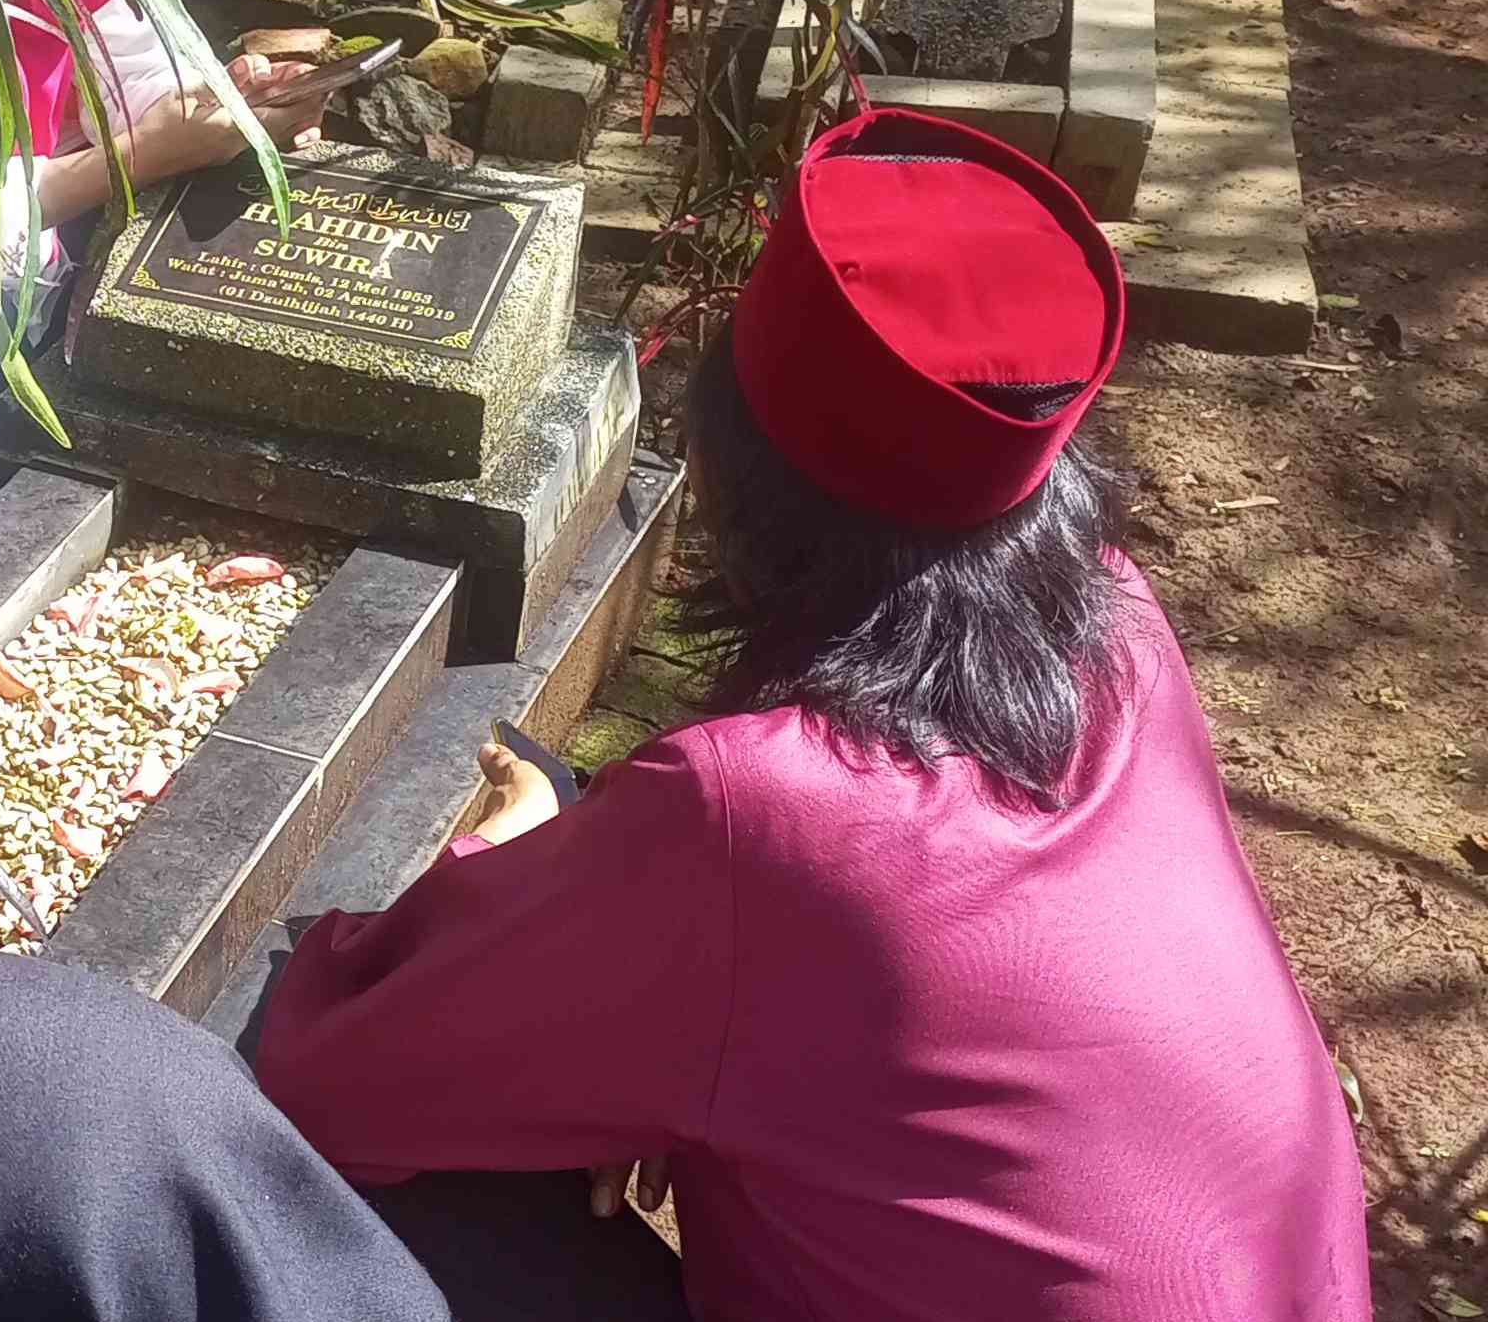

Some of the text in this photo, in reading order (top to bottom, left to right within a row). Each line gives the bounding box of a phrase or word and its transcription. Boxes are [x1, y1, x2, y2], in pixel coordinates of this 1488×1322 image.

[240, 202, 444, 254] H. AHIDIN
[313, 236, 350, 252] Bin
[198, 251, 248, 269] Lahir
[329, 277, 351, 289] 12
[353, 281, 388, 296] Mei
[393, 289, 434, 305] 1953
[253, 239, 393, 280] SUWIRA
[168, 257, 217, 276] Wafat
[314, 286, 335, 299] 02
[337, 291, 410, 314] Agustus
[413, 305, 456, 322] 2019
[219, 284, 416, 332] (01 Dzulhijjah 1440 H)
